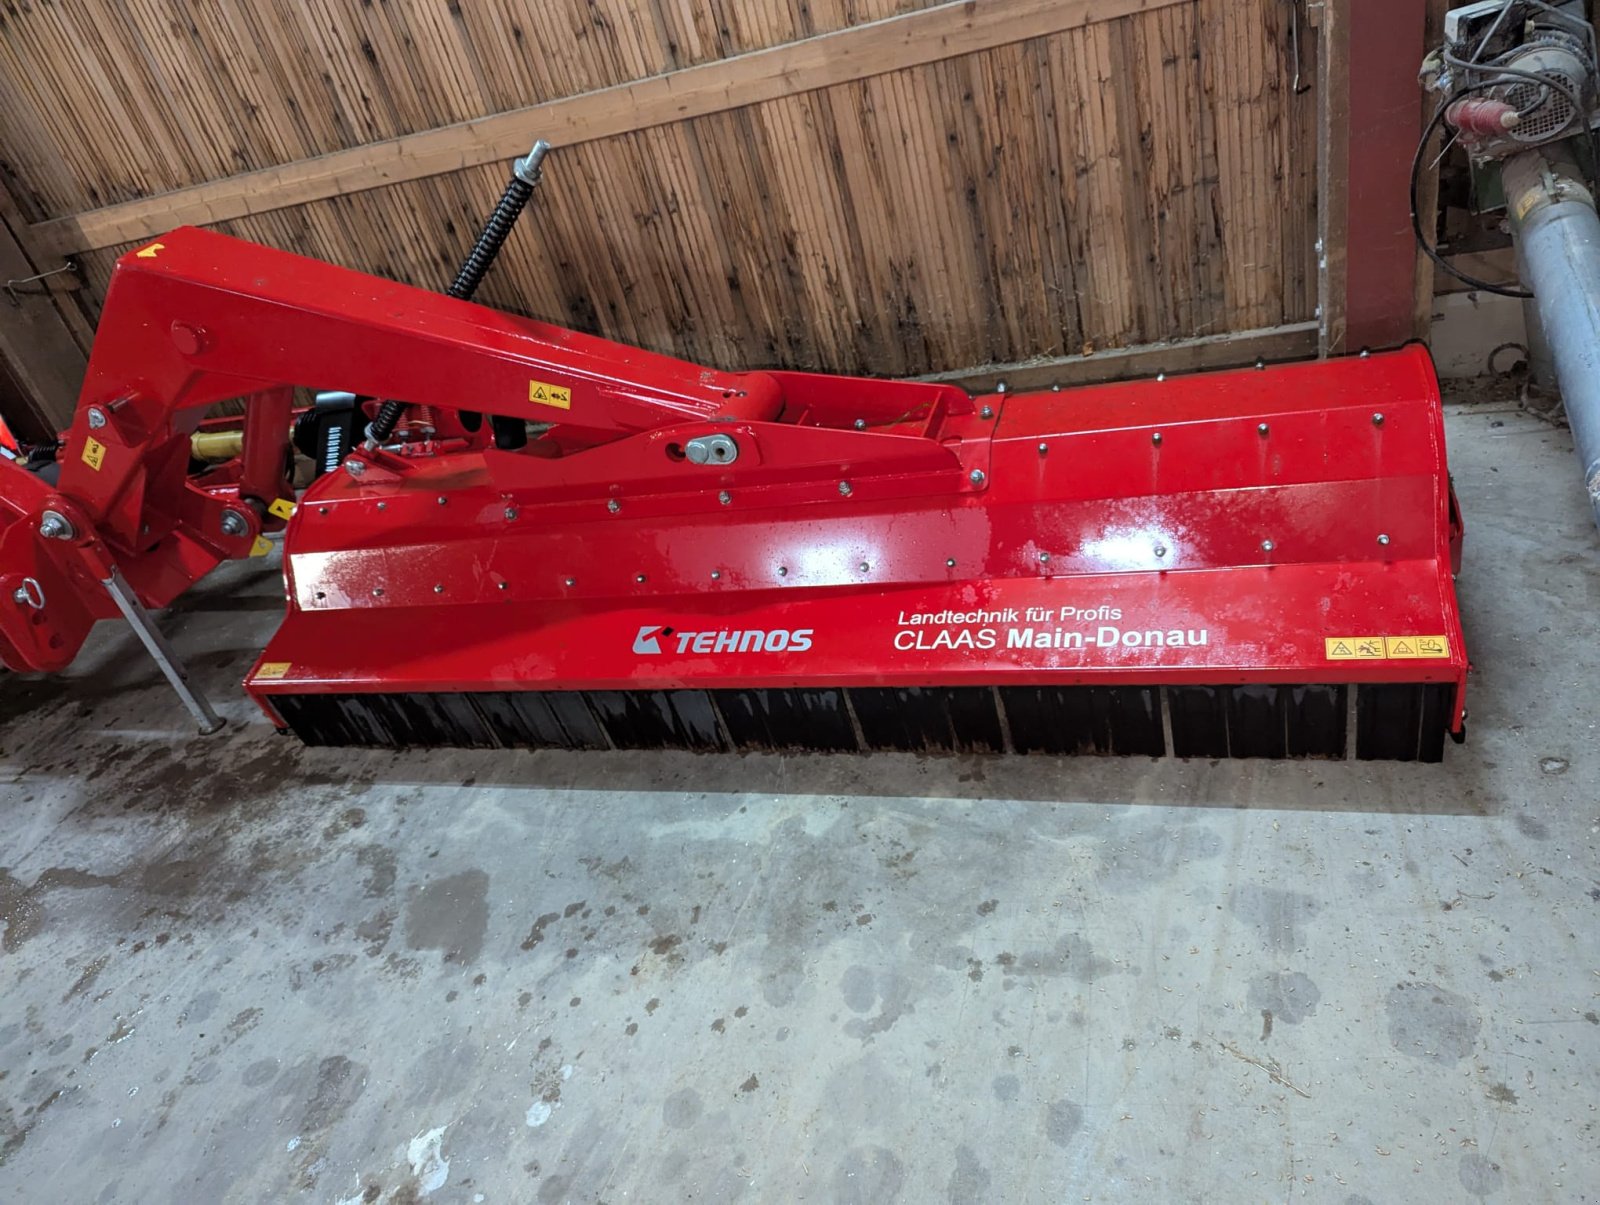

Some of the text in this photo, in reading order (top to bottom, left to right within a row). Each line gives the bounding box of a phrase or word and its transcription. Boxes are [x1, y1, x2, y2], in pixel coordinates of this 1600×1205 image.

[898, 605, 1123, 626] Landtechnik für Profis
[676, 629, 815, 655] TEHNOS
[893, 625, 1209, 651] CLAAS Main-Donau
